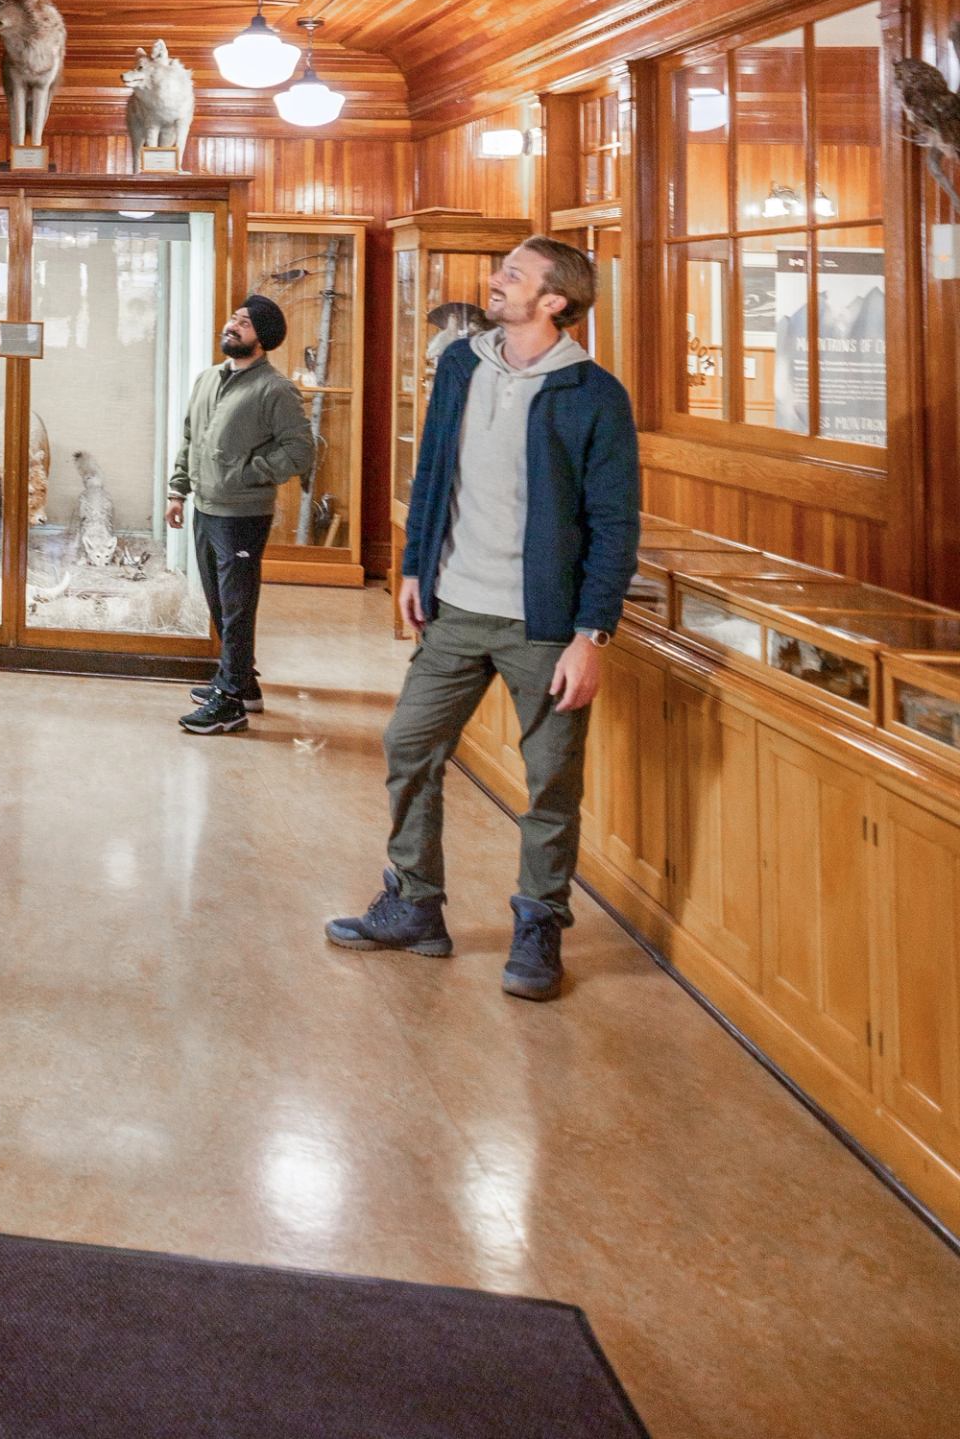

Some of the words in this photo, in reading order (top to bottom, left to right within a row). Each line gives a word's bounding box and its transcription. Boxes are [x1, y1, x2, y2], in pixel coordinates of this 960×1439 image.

[688, 330, 716, 371] OOM
[796, 336, 857, 353] MNTAINS
[860, 338, 872, 353] OF
